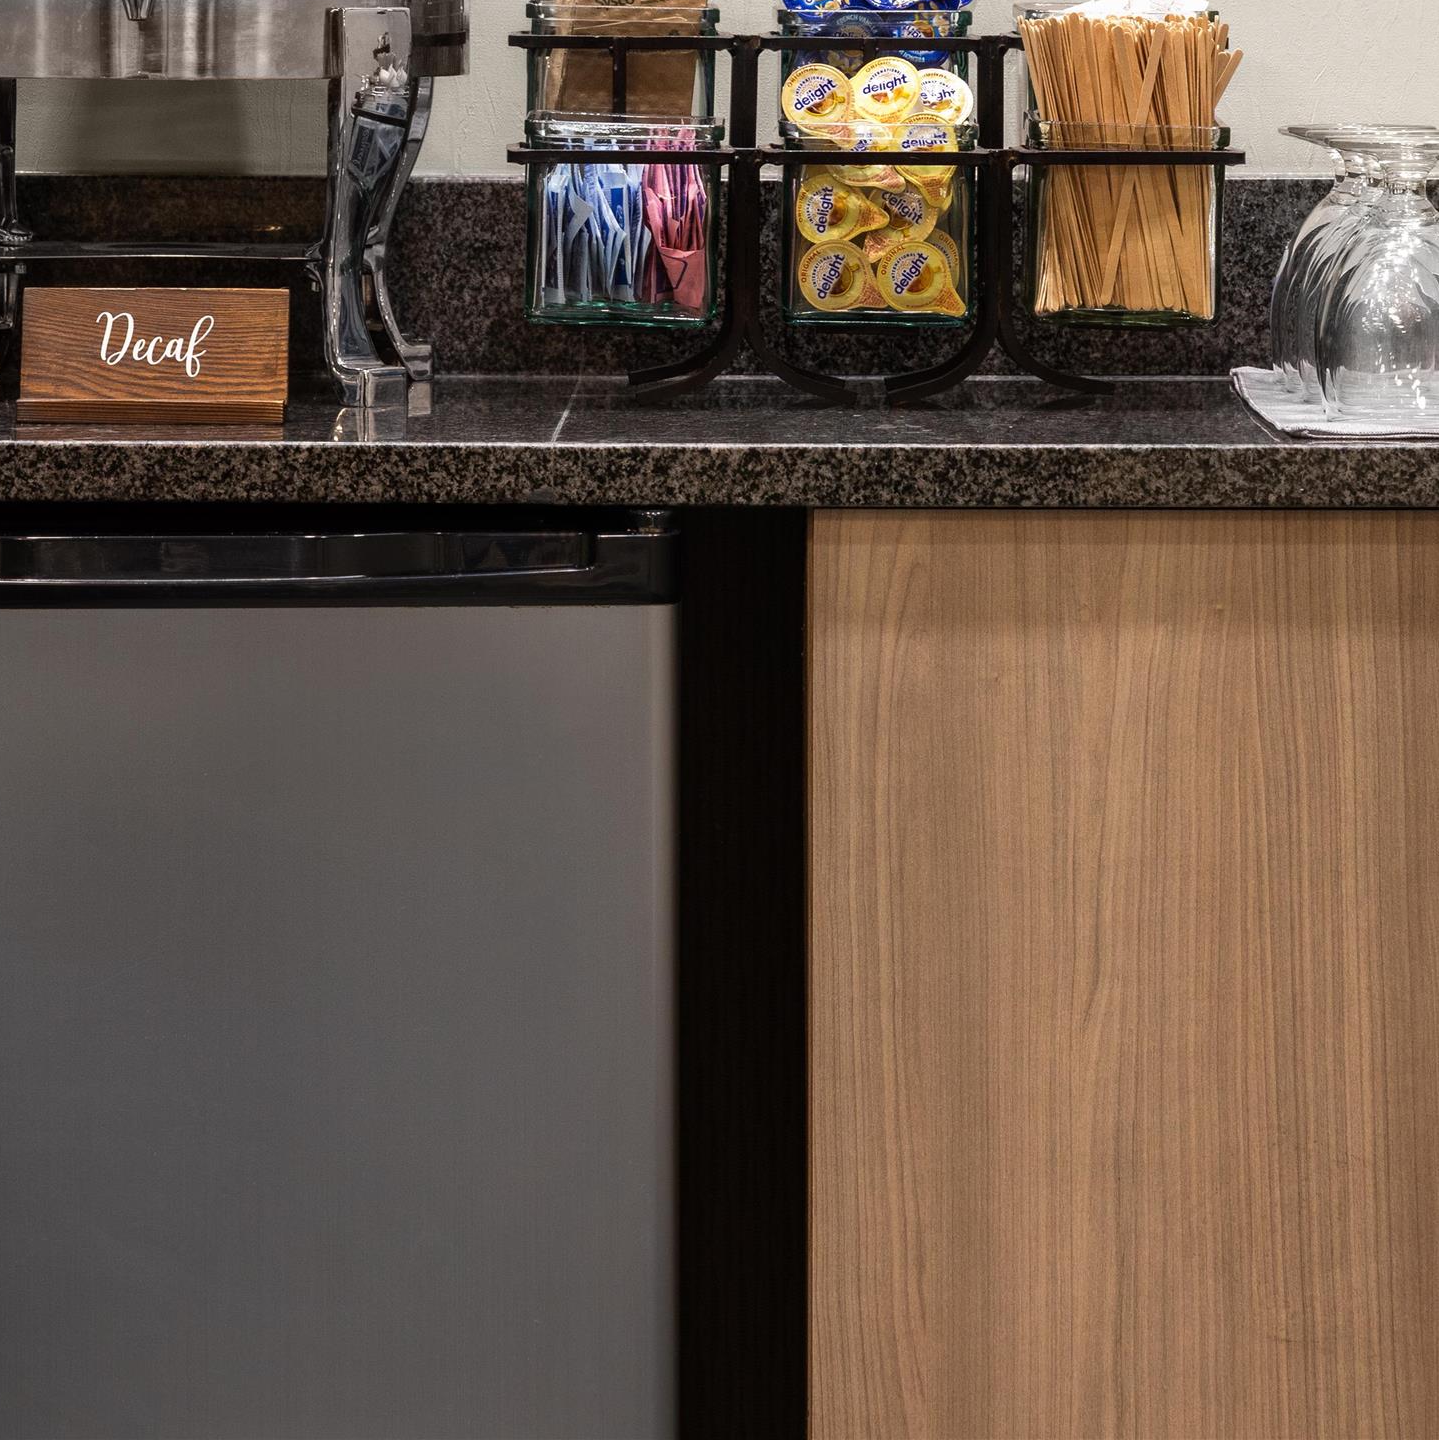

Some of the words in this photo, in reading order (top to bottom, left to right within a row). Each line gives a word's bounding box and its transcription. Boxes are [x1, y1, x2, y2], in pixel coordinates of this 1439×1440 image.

[794, 78, 838, 111] delight
[862, 73, 908, 95] delight
[817, 185, 834, 234] delight
[881, 192, 923, 225] delight
[801, 249, 822, 284] ORIGINAL
[817, 253, 846, 300] delight
[881, 244, 906, 276] ORIGINAL
[894, 252, 930, 295] delight
[96, 311, 215, 378] Decaf
